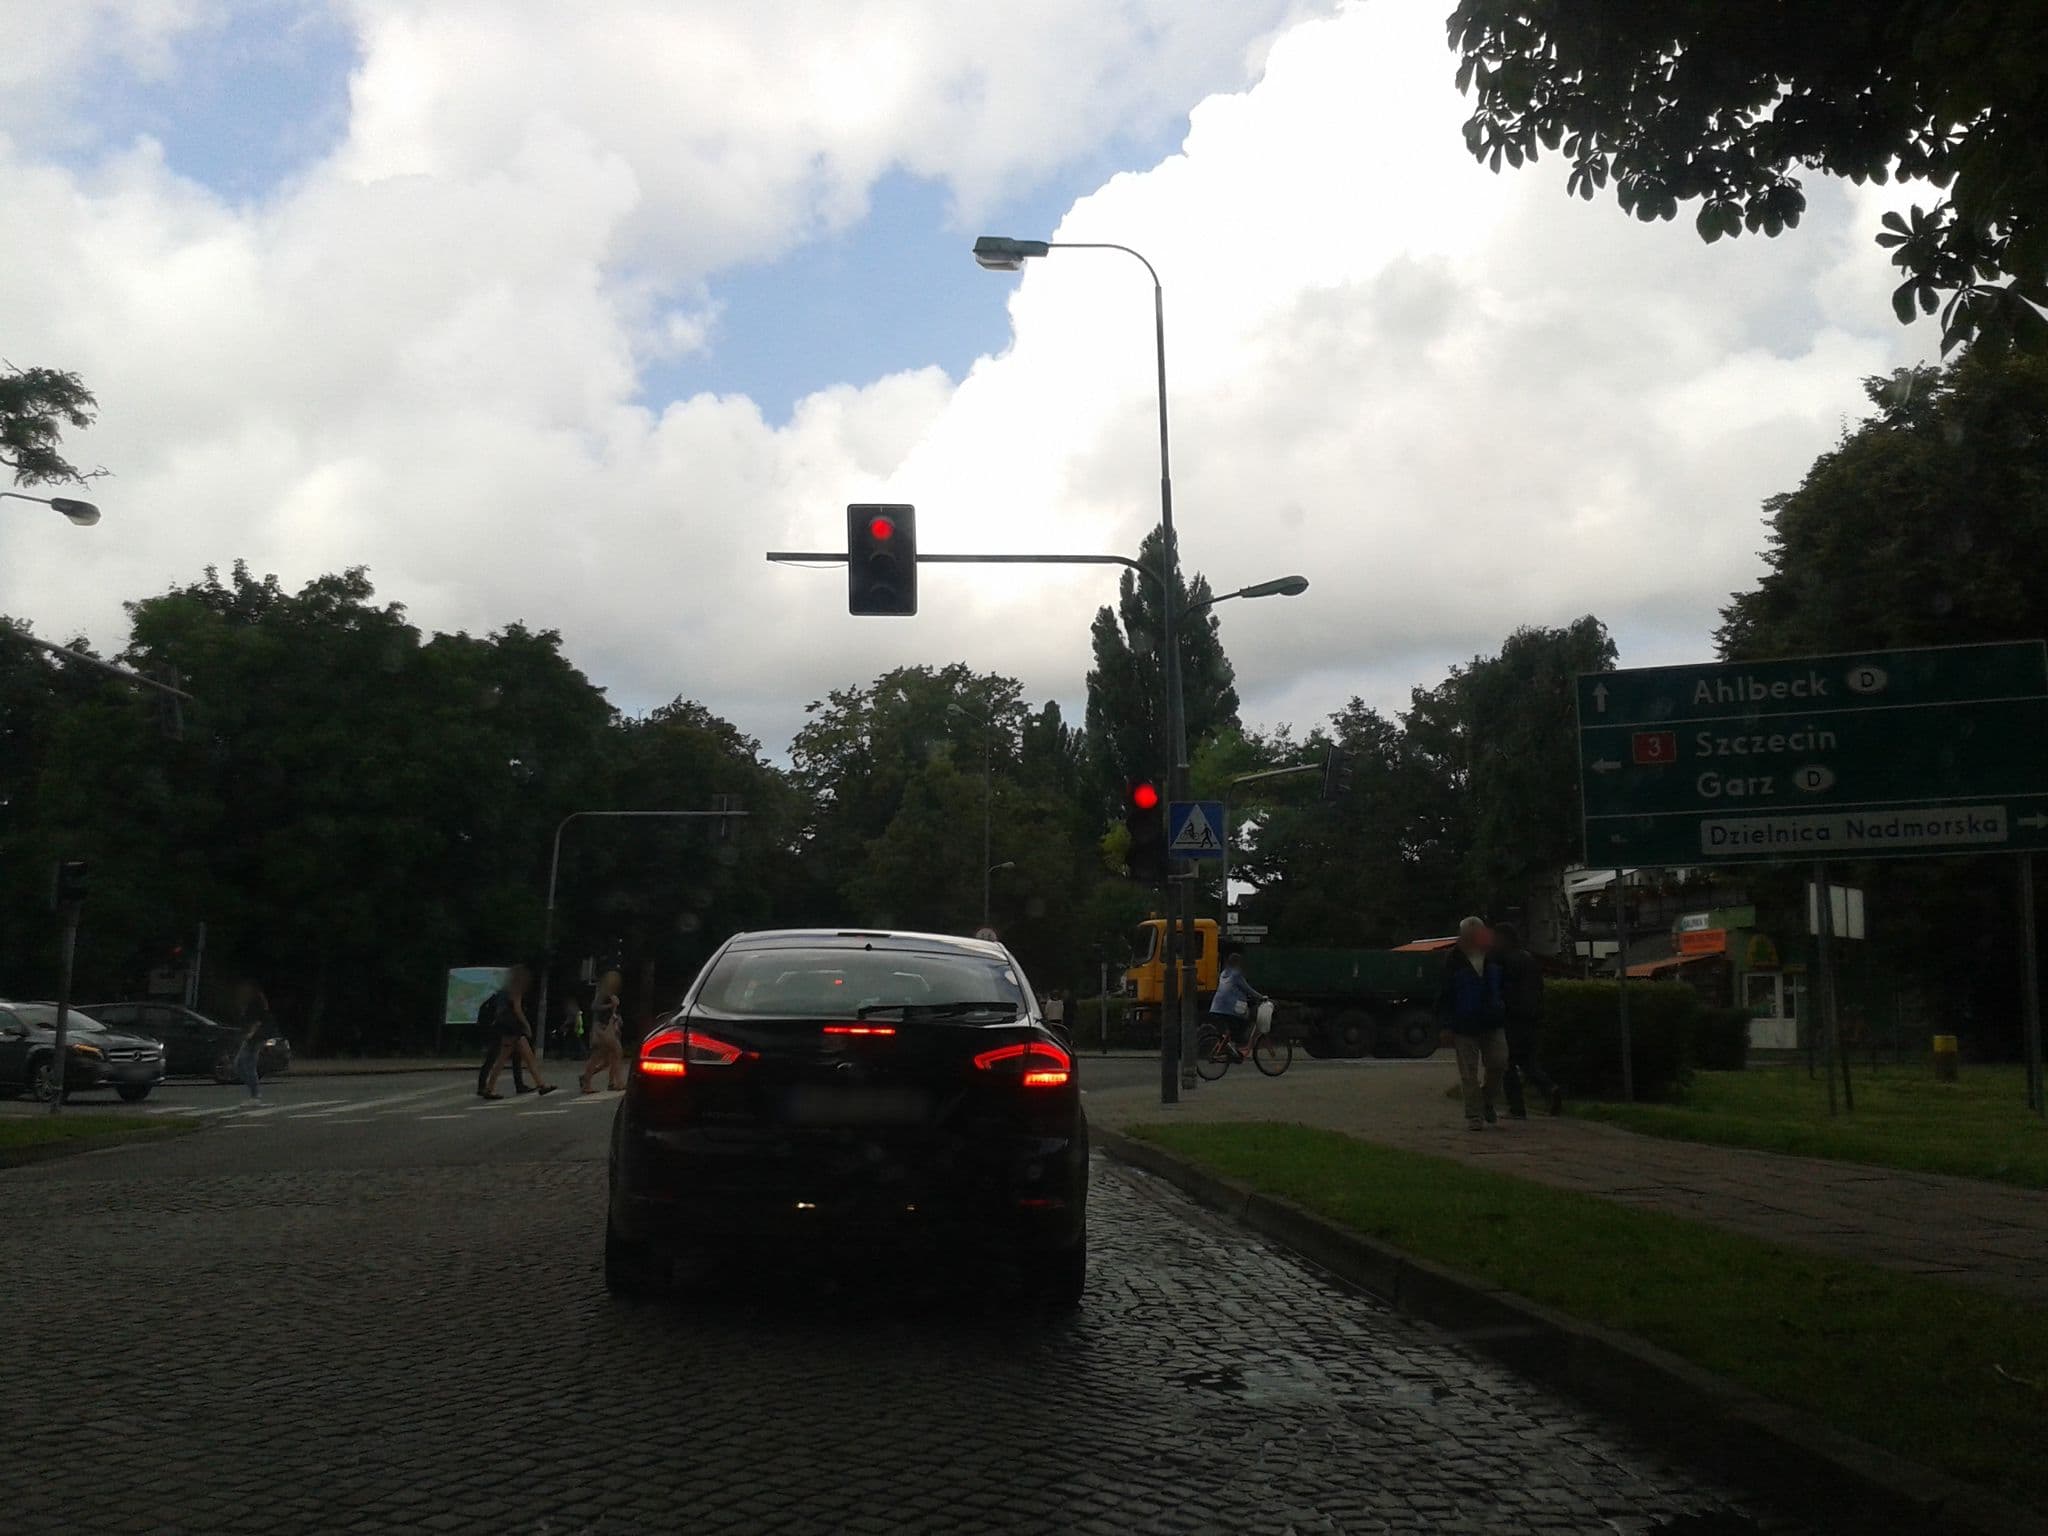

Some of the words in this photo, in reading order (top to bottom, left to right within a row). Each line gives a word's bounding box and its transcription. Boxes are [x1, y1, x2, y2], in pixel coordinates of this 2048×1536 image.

[1693, 672, 1827, 705] Ahlbeck
[1862, 672, 1874, 688] D
[1648, 737, 1661, 758] 3
[1695, 726, 1837, 758] Szczecin
[1696, 771, 1775, 798] Garz
[1807, 771, 1821, 787] D
[1711, 823, 1830, 845] Dzielnica
[1847, 813, 1998, 838] Nadmorska
